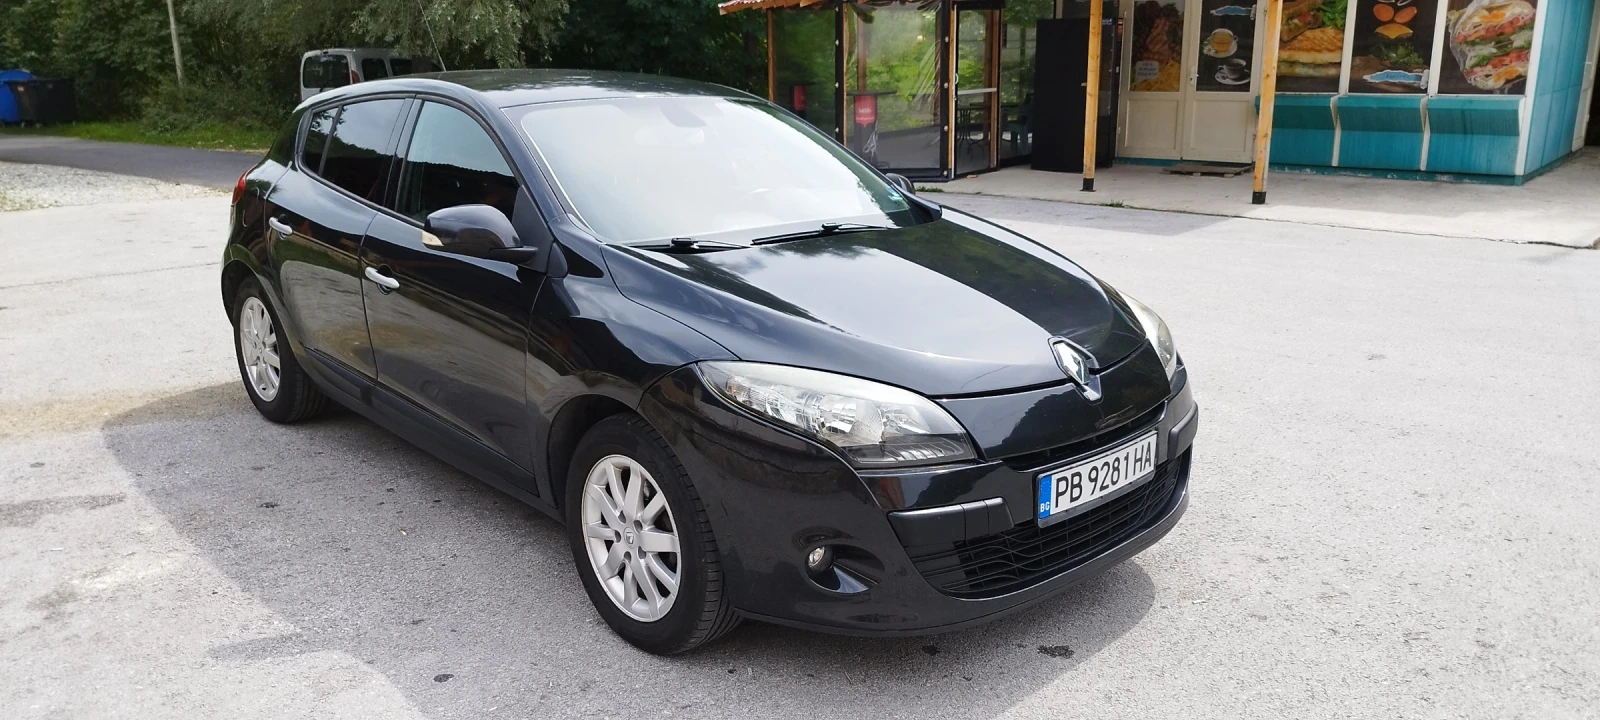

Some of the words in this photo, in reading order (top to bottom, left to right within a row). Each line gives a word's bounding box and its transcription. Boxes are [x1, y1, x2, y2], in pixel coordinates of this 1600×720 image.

[1055, 471, 1083, 509] PB
[1088, 451, 1130, 497] 9281
[1133, 441, 1152, 476] HA
[1040, 501, 1050, 513] BG
